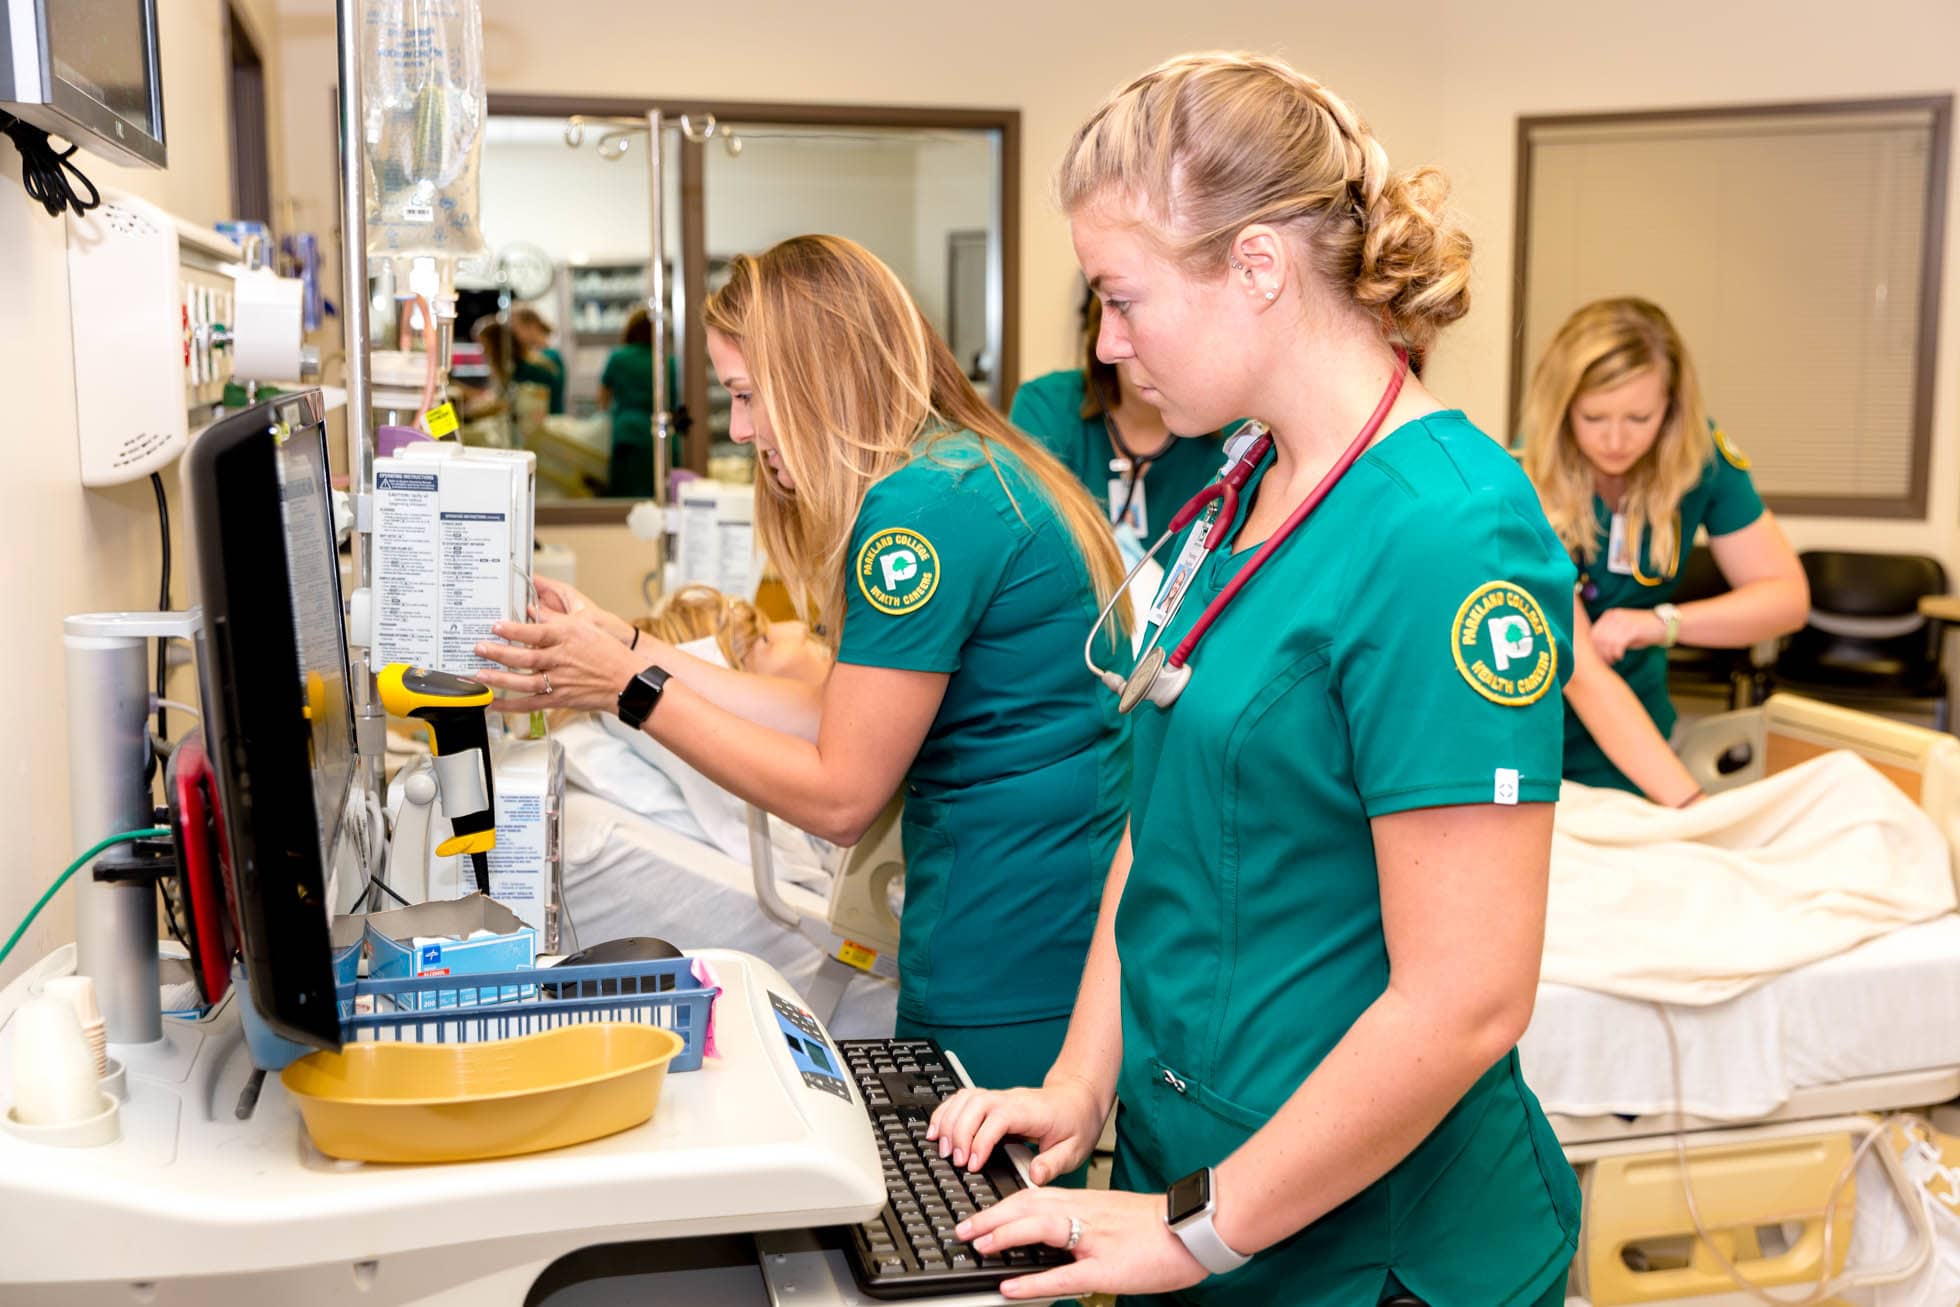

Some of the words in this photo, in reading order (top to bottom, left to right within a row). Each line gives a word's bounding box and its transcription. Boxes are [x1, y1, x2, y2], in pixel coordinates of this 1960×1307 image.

[864, 536, 893, 575] PARKLAND
[895, 534, 930, 562] COLLEGE
[870, 585, 900, 607] HEALTH
[902, 572, 932, 605] CAREERS
[1462, 591, 1504, 645] PARKLAND
[1507, 592, 1544, 635] COLLEGE
[1471, 659, 1514, 694] HEALTH
[1517, 651, 1550, 694] CAREERS
